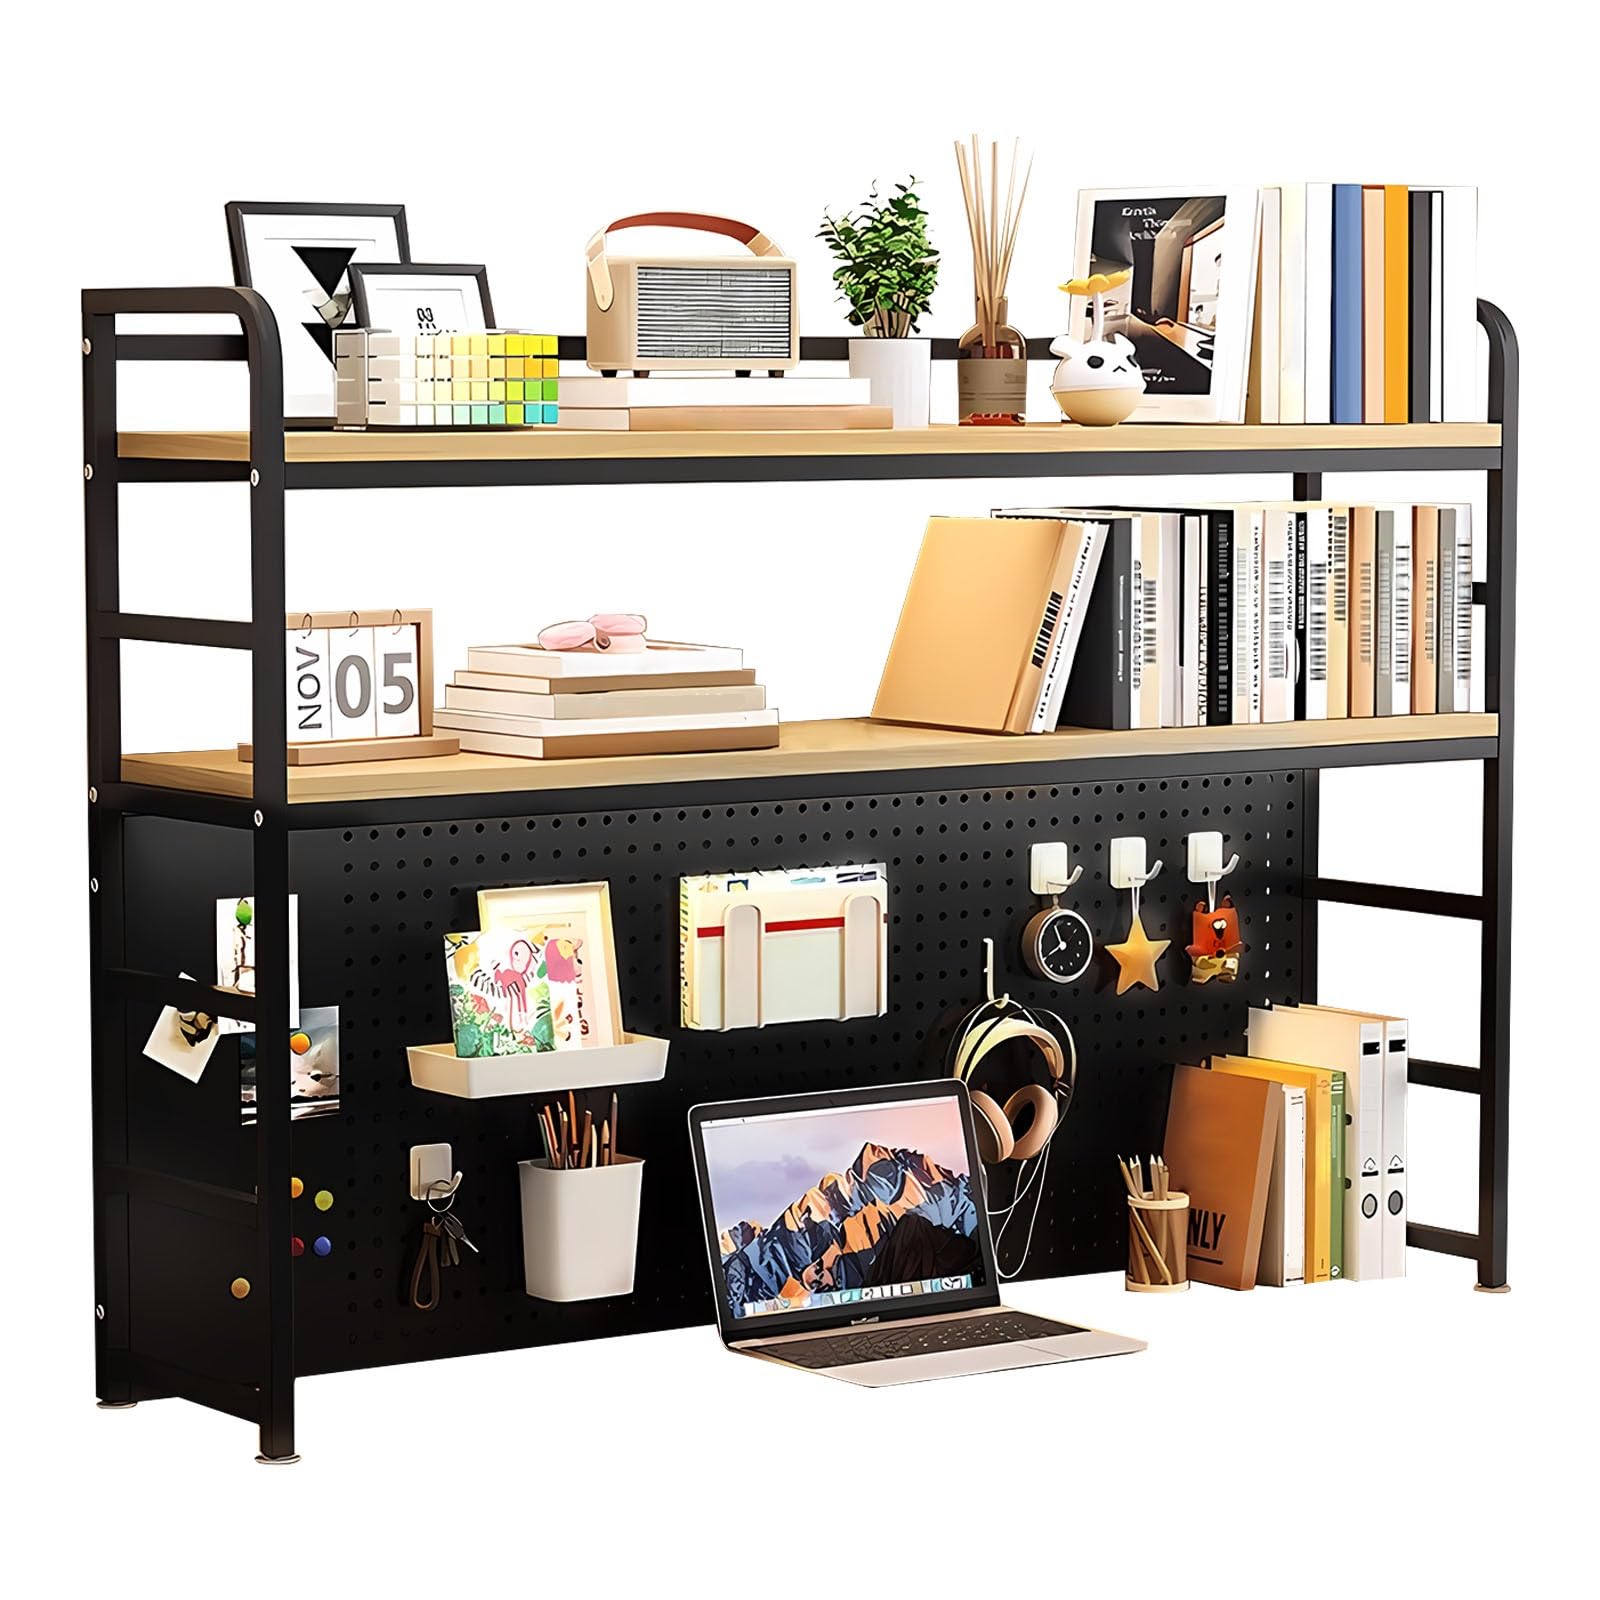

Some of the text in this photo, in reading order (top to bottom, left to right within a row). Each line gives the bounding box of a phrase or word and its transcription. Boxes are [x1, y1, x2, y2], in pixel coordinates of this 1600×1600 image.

[296, 646, 322, 729] NOV
[335, 652, 414, 719] 05
[1187, 1208, 1226, 1250] NLY
